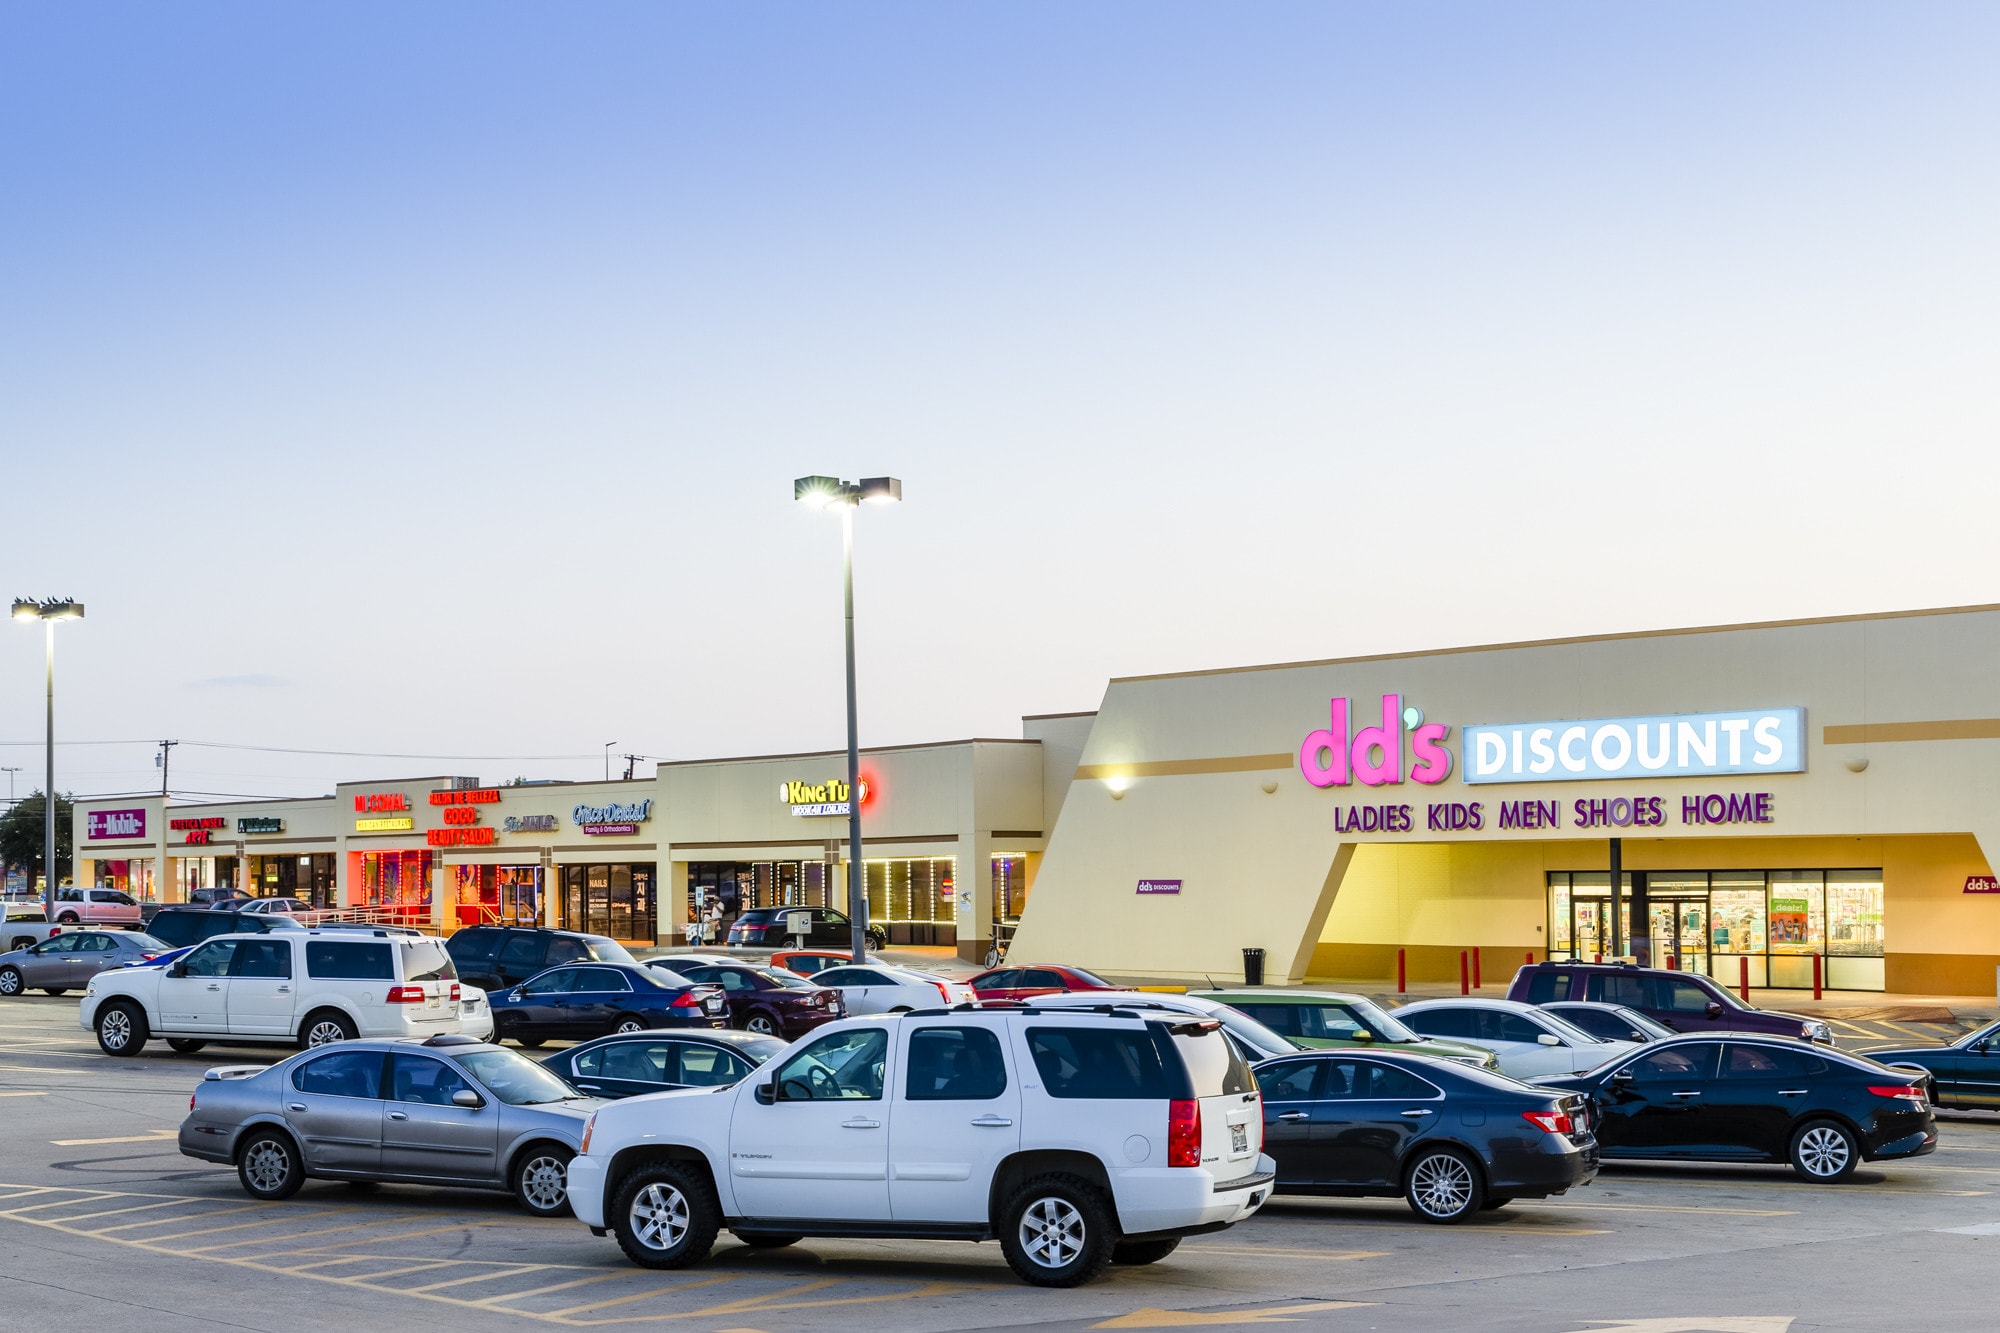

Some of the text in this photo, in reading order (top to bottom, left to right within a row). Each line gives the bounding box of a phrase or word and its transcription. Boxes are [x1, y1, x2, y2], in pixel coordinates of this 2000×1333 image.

[1300, 694, 1783, 787] dd's DISCOUNTS
[429, 790, 499, 805] SALON DE BELLEZA
[788, 781, 826, 804] KING
[354, 792, 406, 812] MI COMAL
[443, 807, 475, 825] COCO
[572, 799, 649, 826] Grace Dental
[1334, 793, 1773, 832] LADIES KIDS MEN SHOES HOME
[170, 817, 222, 830] ESTETICA UNISEX
[358, 819, 411, 830] MEXICAN RESTAURANT
[523, 815, 554, 831] NAILS
[427, 827, 493, 847] BEAUTY SALON
[589, 879, 607, 888] NAILS
[1139, 881, 1153, 891] dd's
[1967, 879, 1989, 890] dd's
